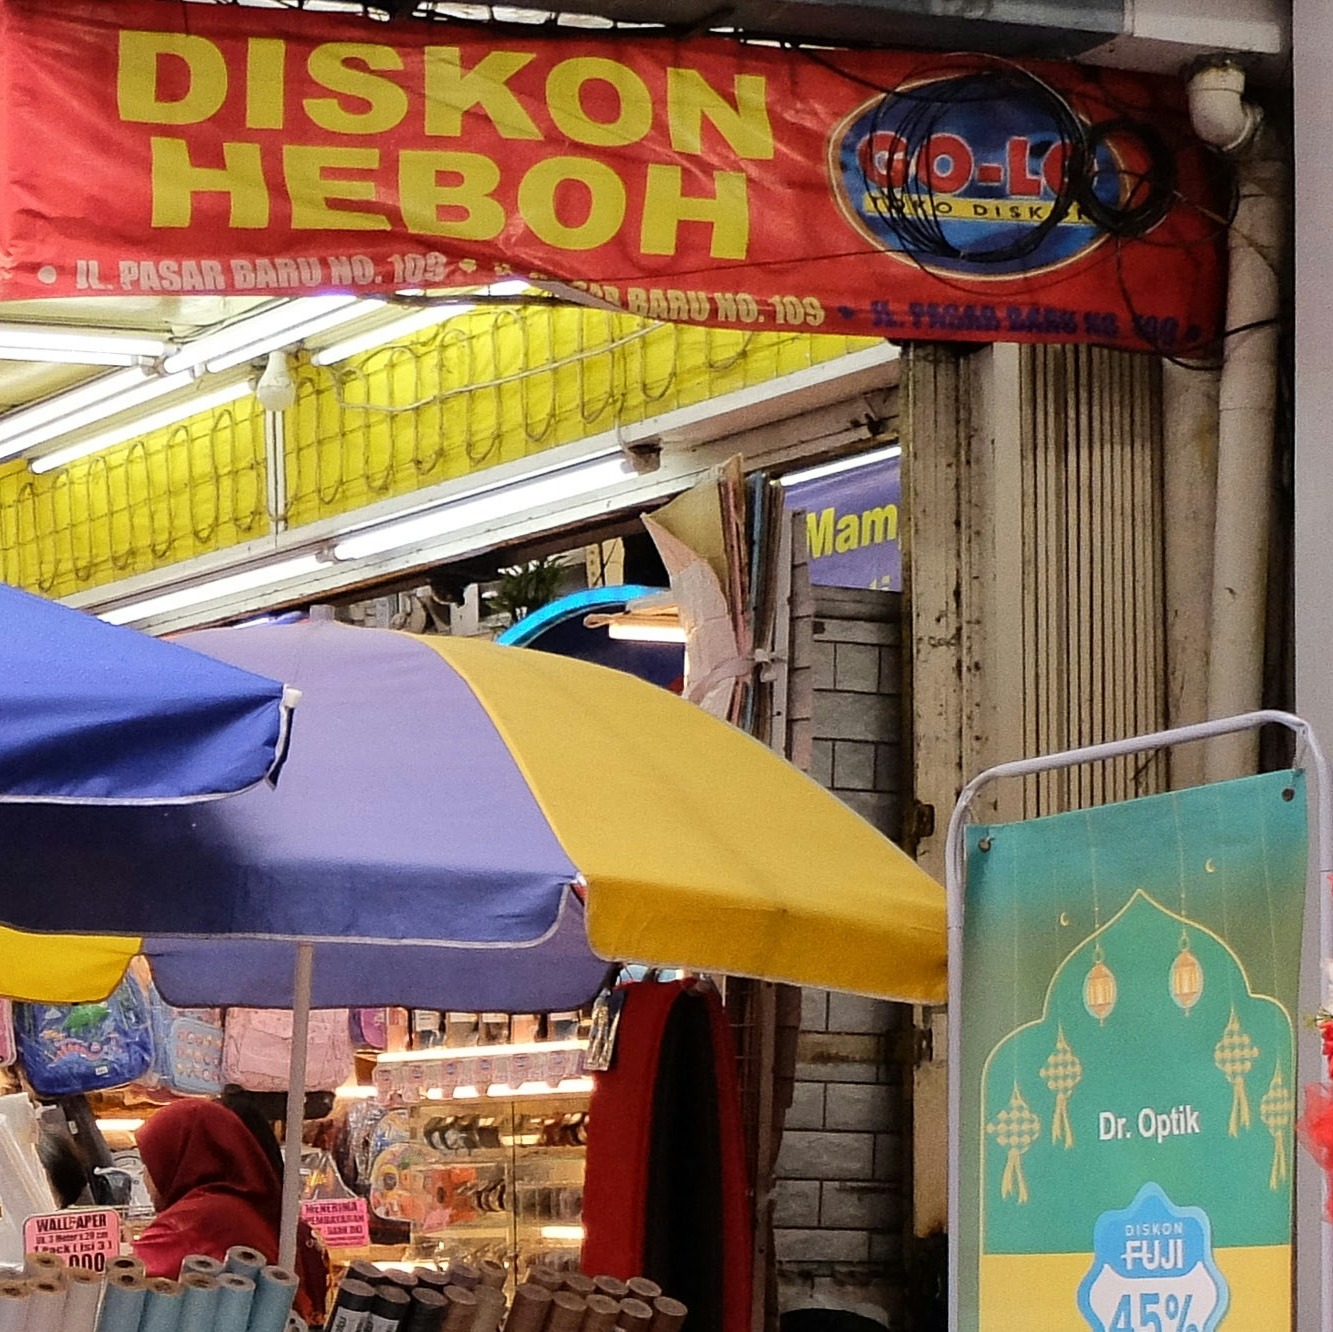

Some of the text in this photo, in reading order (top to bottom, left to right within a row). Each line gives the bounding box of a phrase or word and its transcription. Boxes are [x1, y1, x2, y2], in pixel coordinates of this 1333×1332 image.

[117, 29, 775, 160] DISKON
[150, 136, 750, 261] HEBOH
[76, 260, 113, 291] JL.
[120, 257, 226, 292] PASAR
[234, 255, 321, 291] BARU
[332, 254, 383, 287] NO.
[628, 287, 826, 326] BARU NO. 109
[807, 503, 901, 559] Mam
[1099, 1105, 1201, 1143] Dr. Optik
[36, 1213, 107, 1233] WALLPAPER
[1125, 1223, 1183, 1237] DISKON
[1121, 1239, 1183, 1270] FUJI
